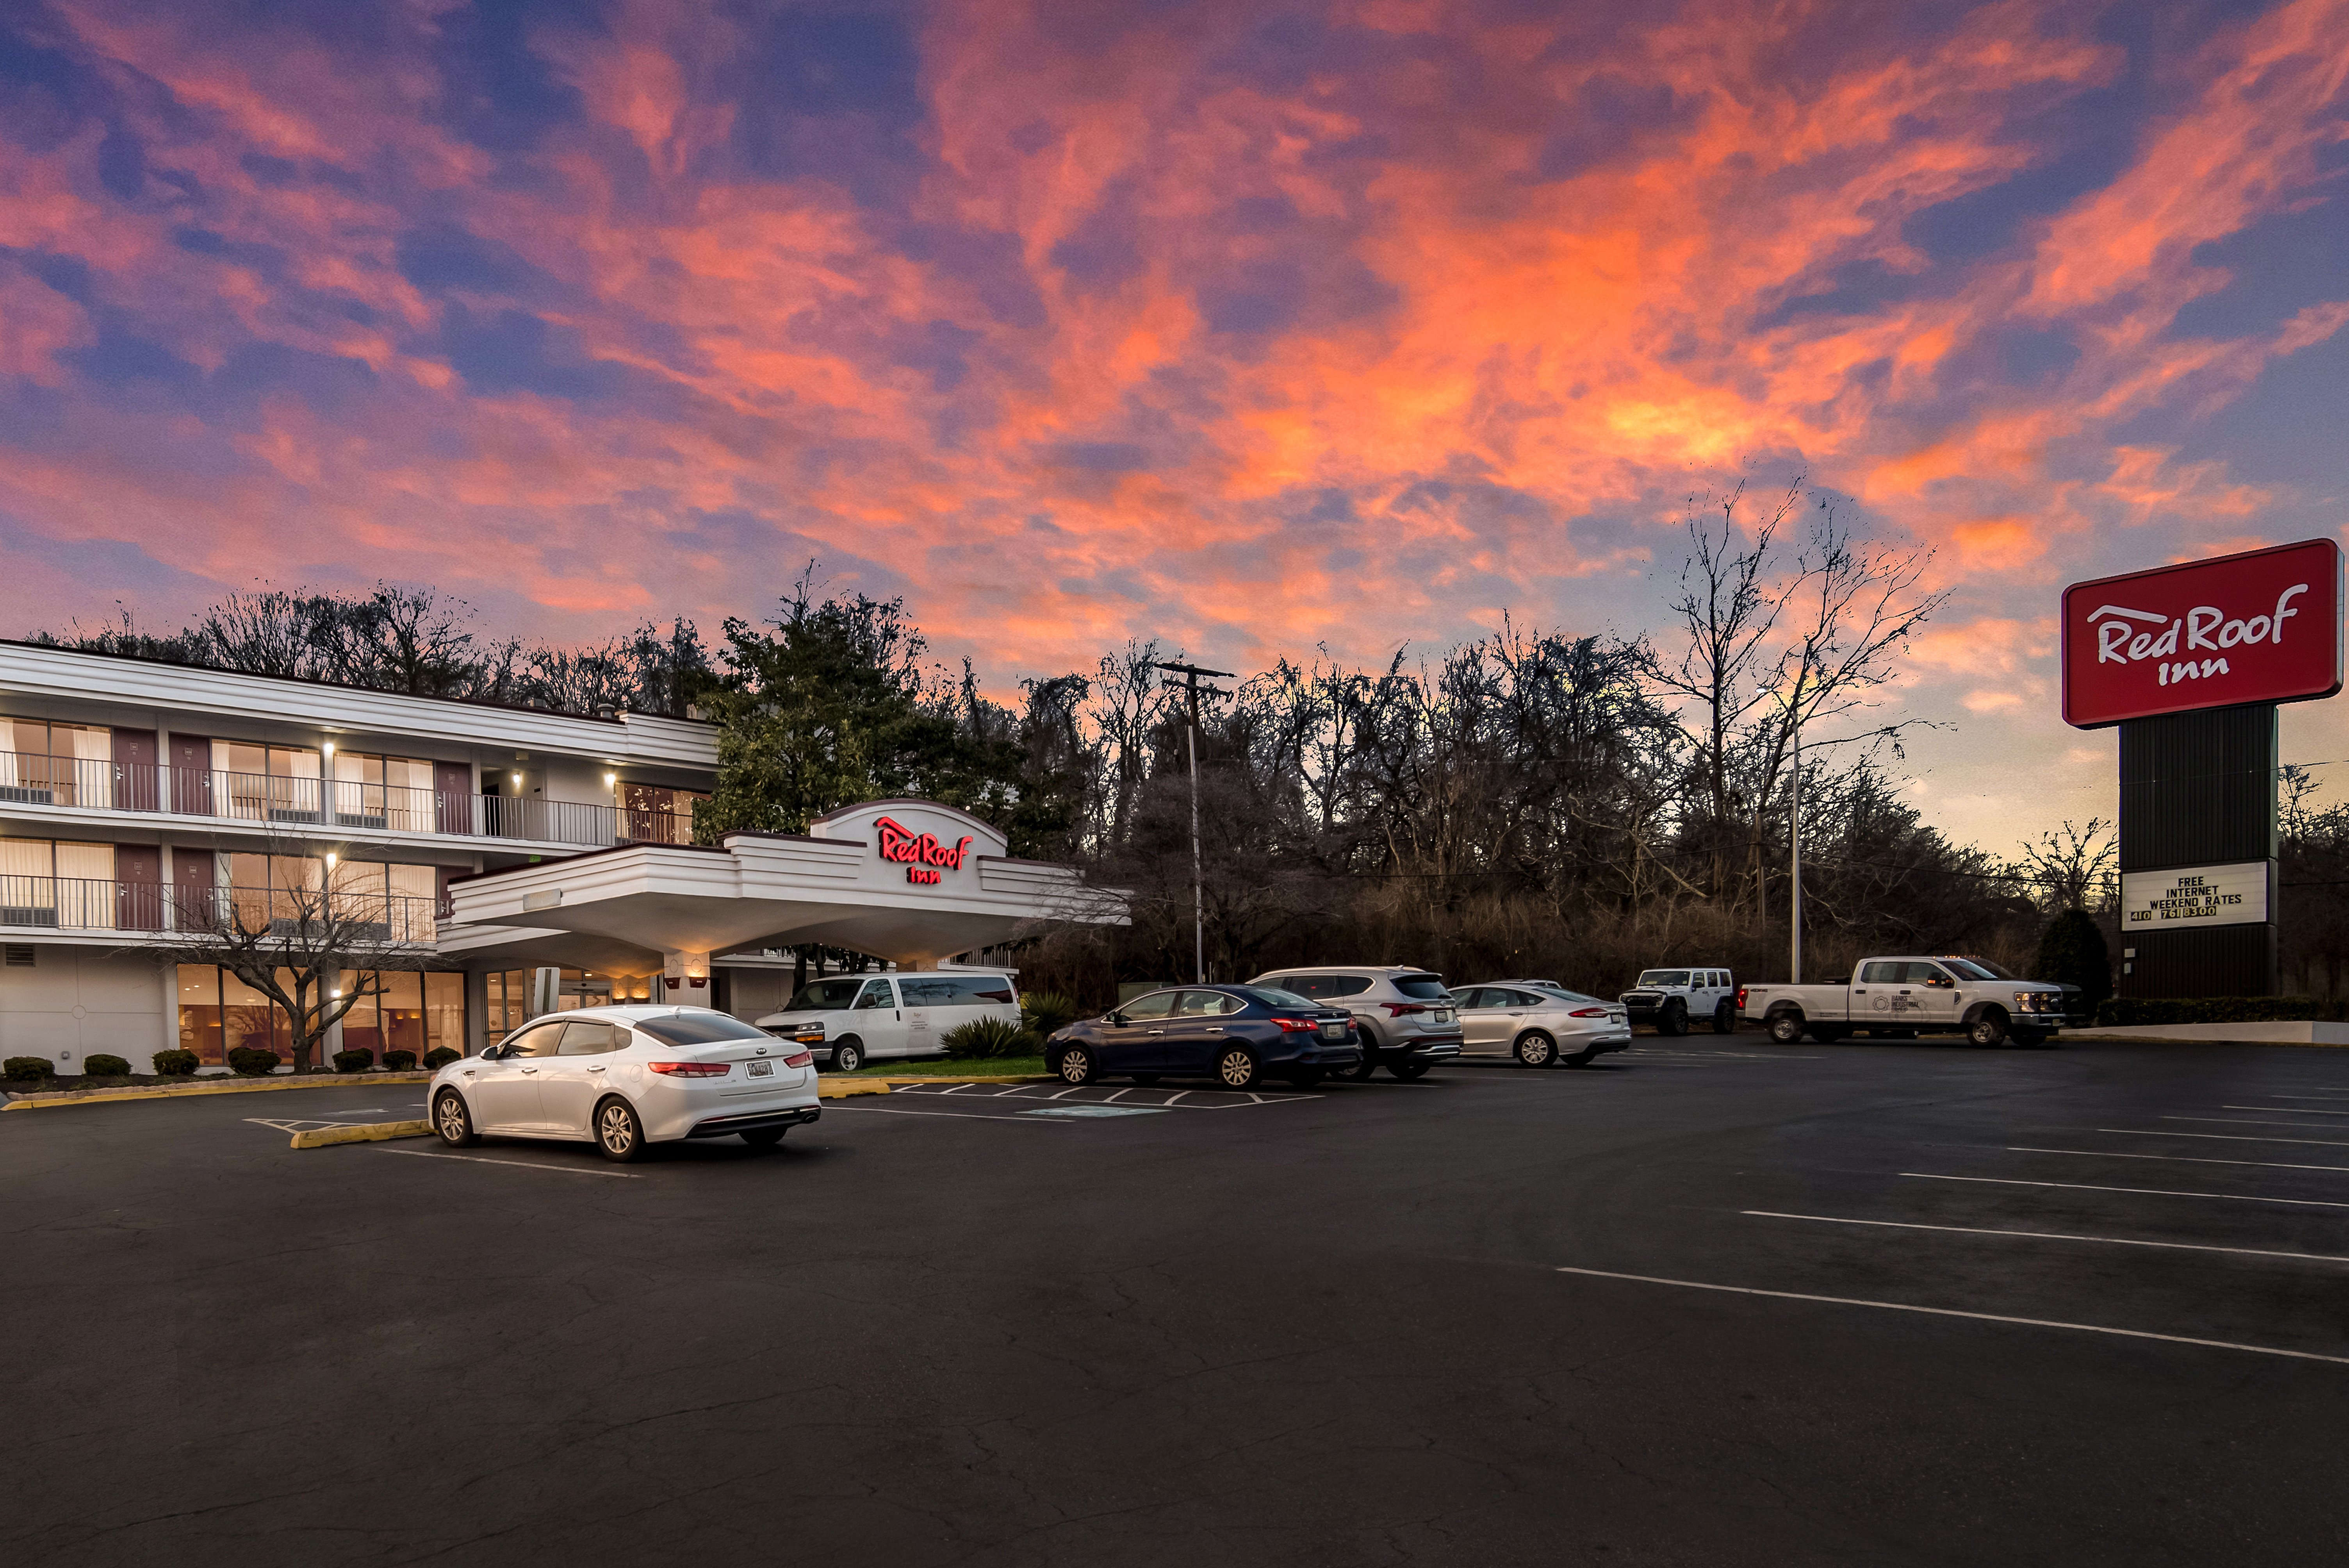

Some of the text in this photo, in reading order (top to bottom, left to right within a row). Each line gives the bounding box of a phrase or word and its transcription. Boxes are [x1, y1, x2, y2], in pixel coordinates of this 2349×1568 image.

[2098, 584, 2308, 664] Red Roof
[2158, 658, 2230, 686] Inn
[881, 828, 973, 871] Red Roof
[909, 866, 941, 884] Inn
[2178, 876, 2204, 887] FREE
[2166, 885, 2219, 898] INTERNET
[2150, 894, 2242, 910] WEEKEND RATES
[2131, 911, 2151, 920] 410
